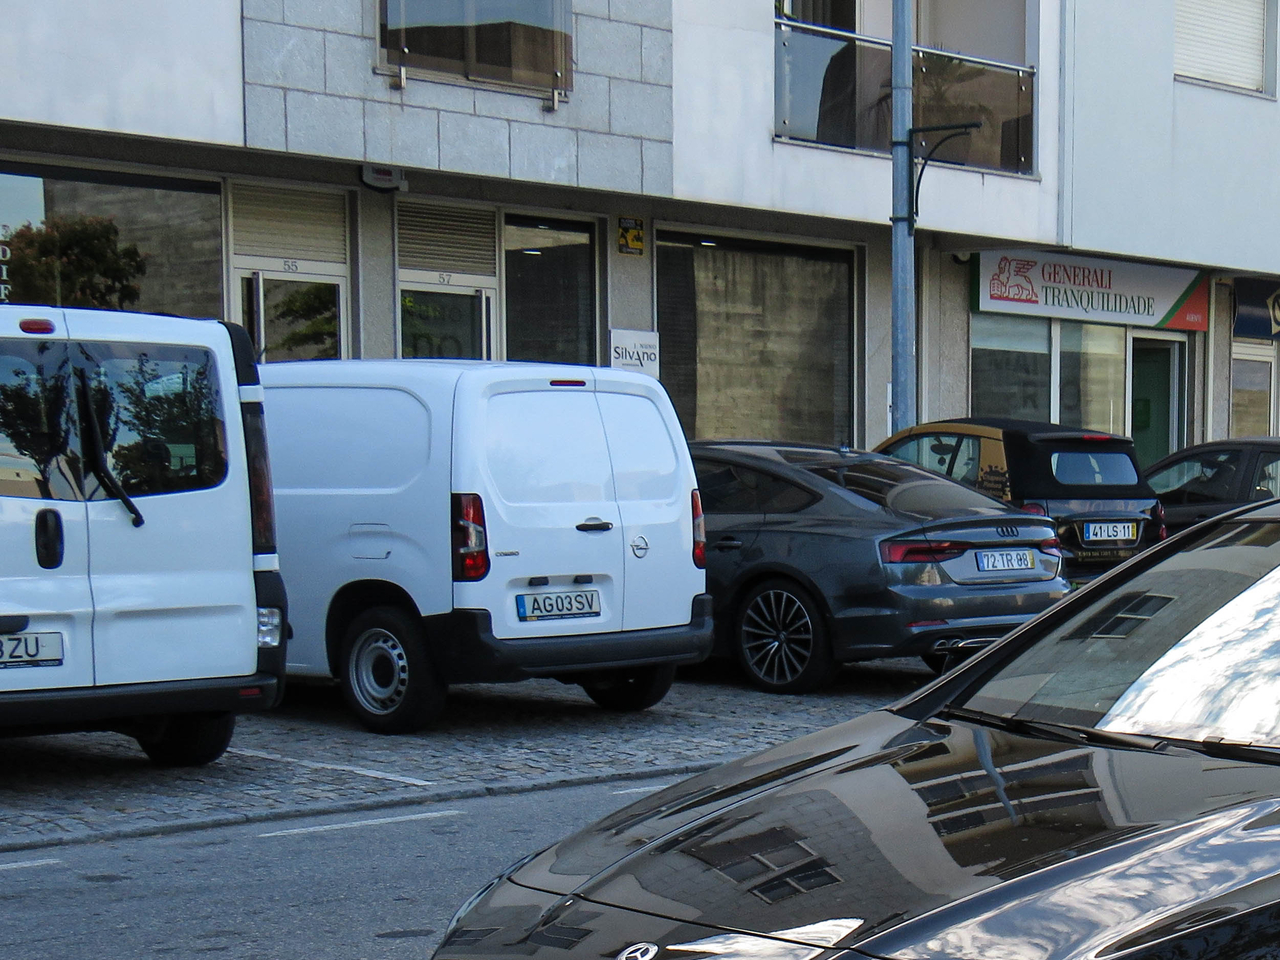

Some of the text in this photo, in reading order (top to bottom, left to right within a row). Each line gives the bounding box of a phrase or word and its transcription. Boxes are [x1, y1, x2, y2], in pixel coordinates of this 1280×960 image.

[283, 260, 298, 272] 55
[1041, 262, 1113, 290] GENERALI
[438, 273, 452, 285] 57
[1041, 286, 1155, 316] TRANQUILIDADE
[531, 593, 594, 614] AG03SV
